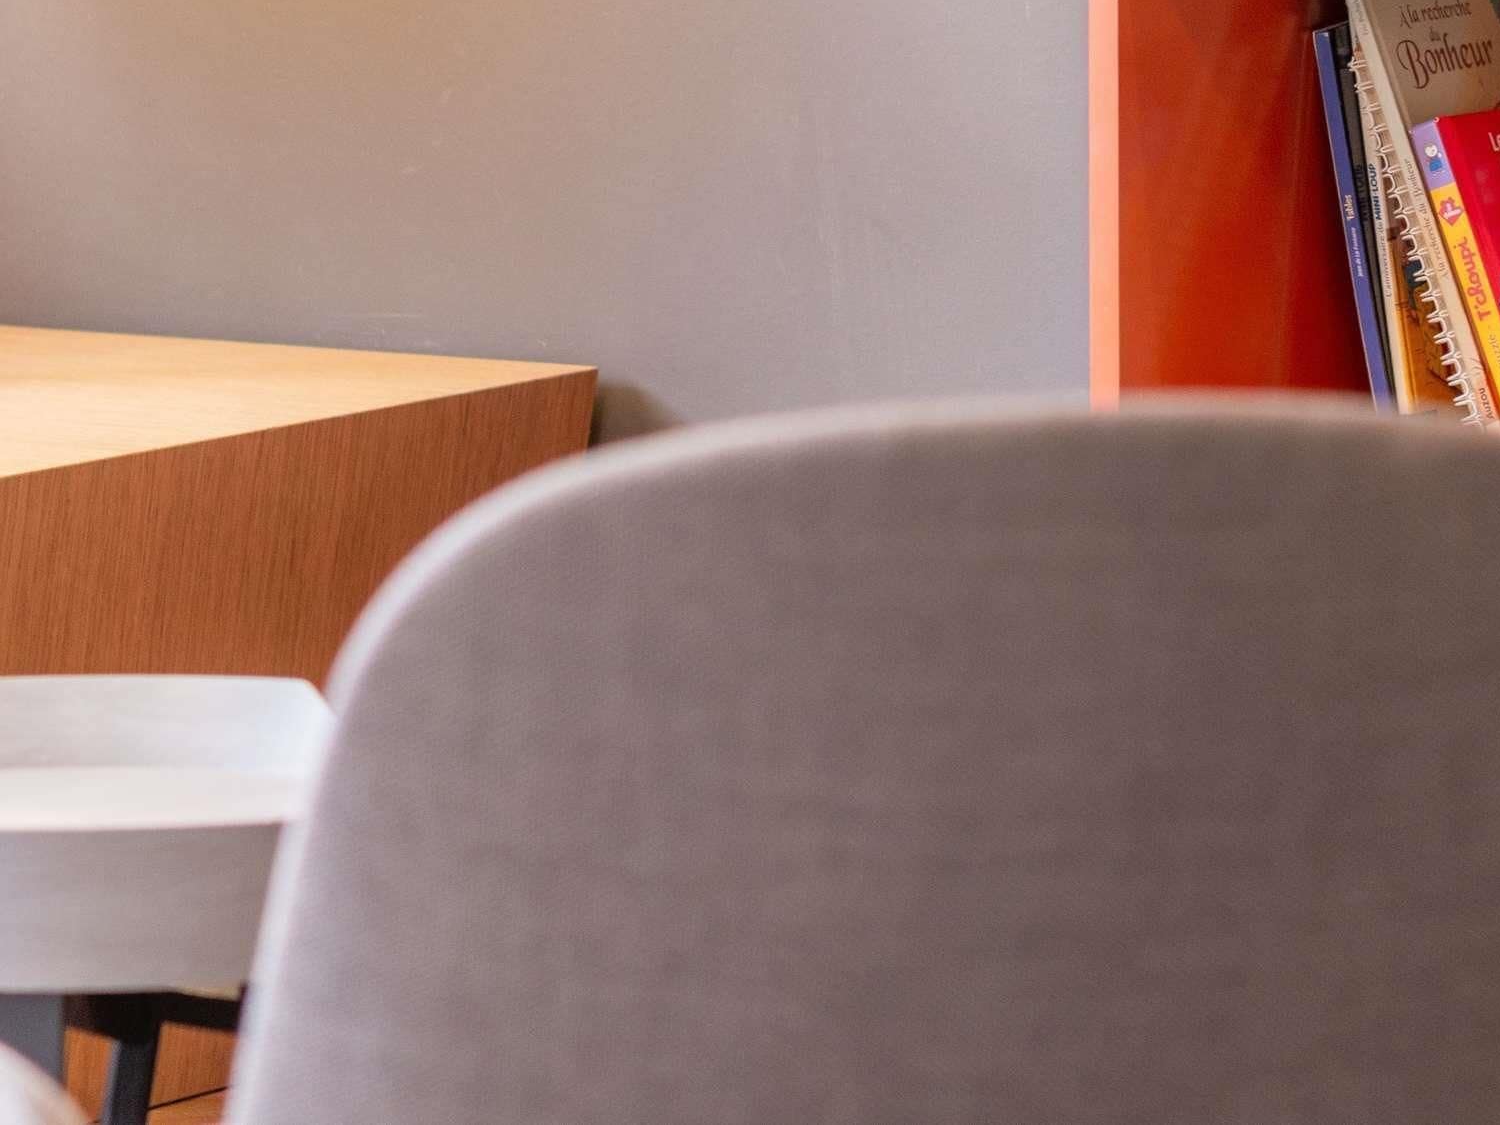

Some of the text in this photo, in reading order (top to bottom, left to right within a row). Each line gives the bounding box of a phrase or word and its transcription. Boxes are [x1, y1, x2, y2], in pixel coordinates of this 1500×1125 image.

[1395, 32, 1493, 90] Bonheur
[1429, 25, 1441, 42] du
[1367, 162, 1382, 220] MINI-LOUP
[1460, 236, 1491, 322] T'choupi
